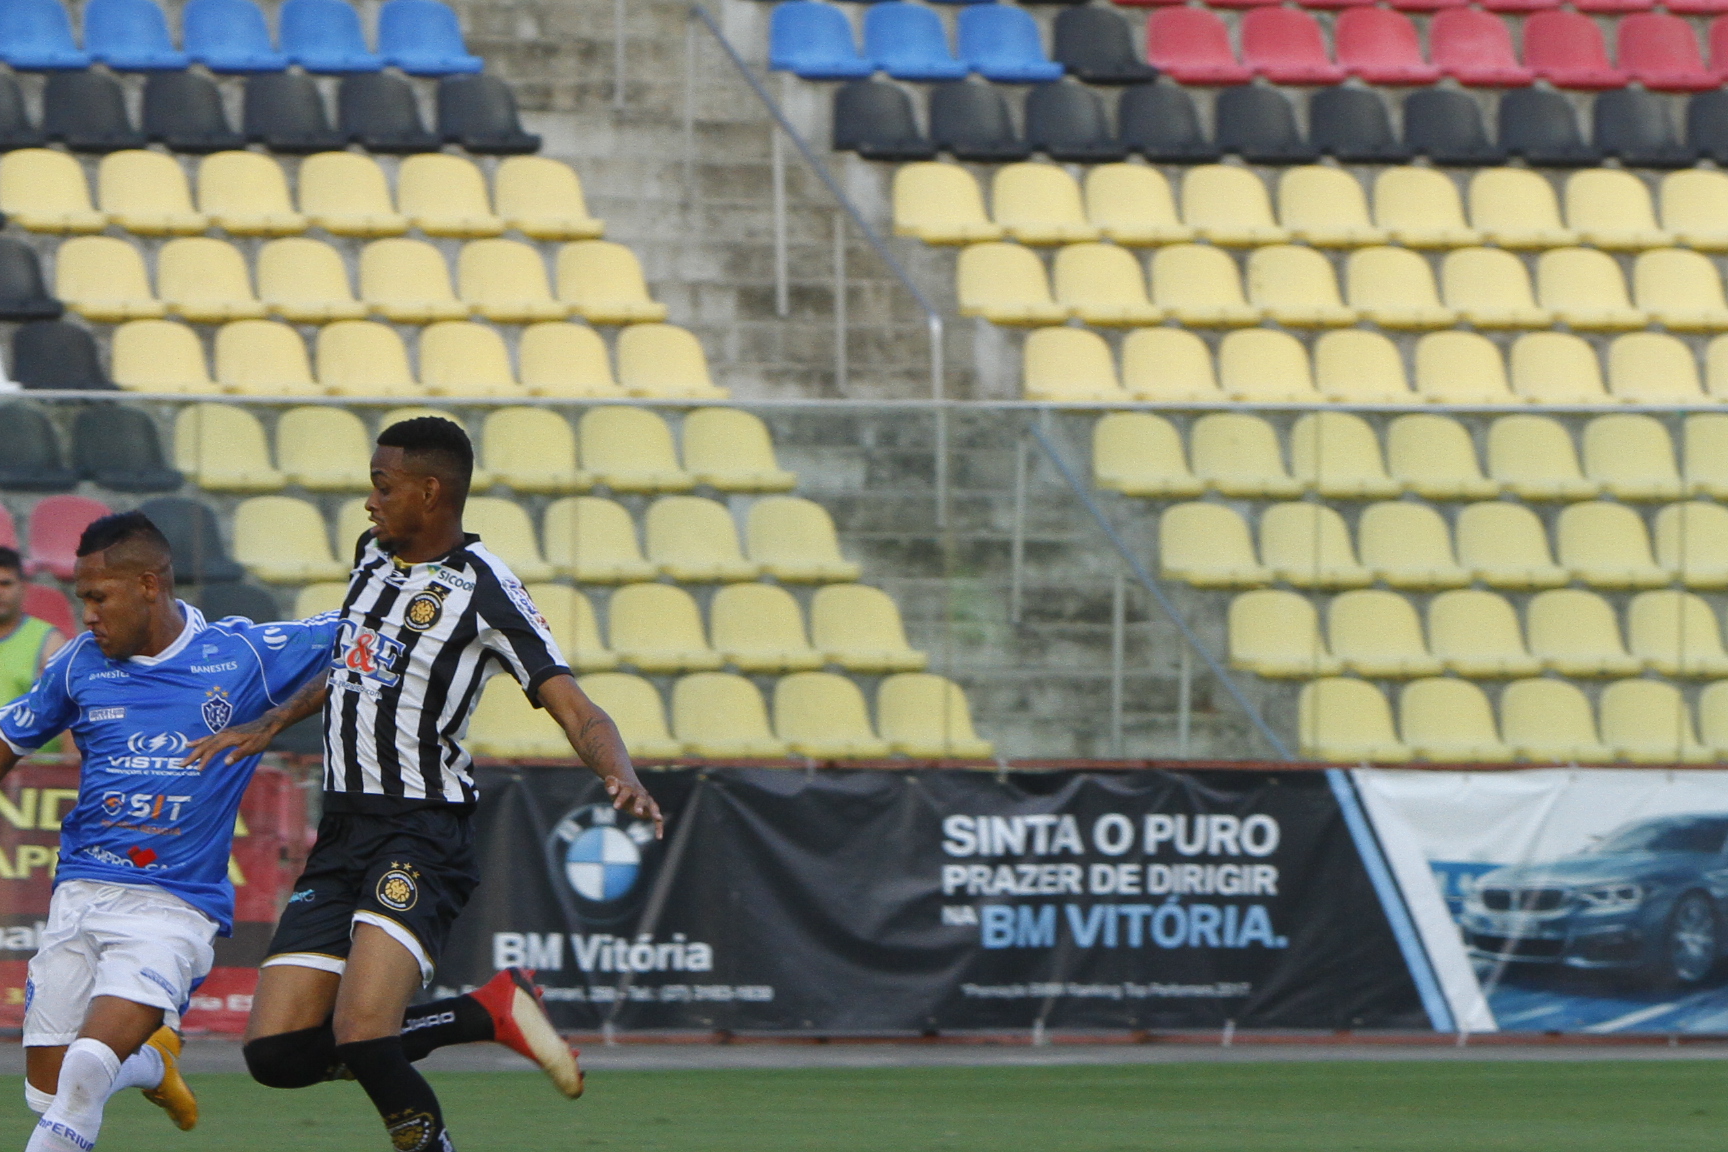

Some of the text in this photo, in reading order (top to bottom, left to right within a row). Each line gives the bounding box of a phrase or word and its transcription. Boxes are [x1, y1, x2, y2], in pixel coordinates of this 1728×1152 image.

[190, 661, 238, 673] BANESTES
[942, 813, 1281, 857] SINTA O PURO
[942, 864, 1279, 896] PRAZER DE DIRIGIR
[941, 895, 1289, 949] NA BM VITÓRIA.
[493, 931, 714, 973] BM Vitória
[37, 1117, 95, 1152] MPERIUM
